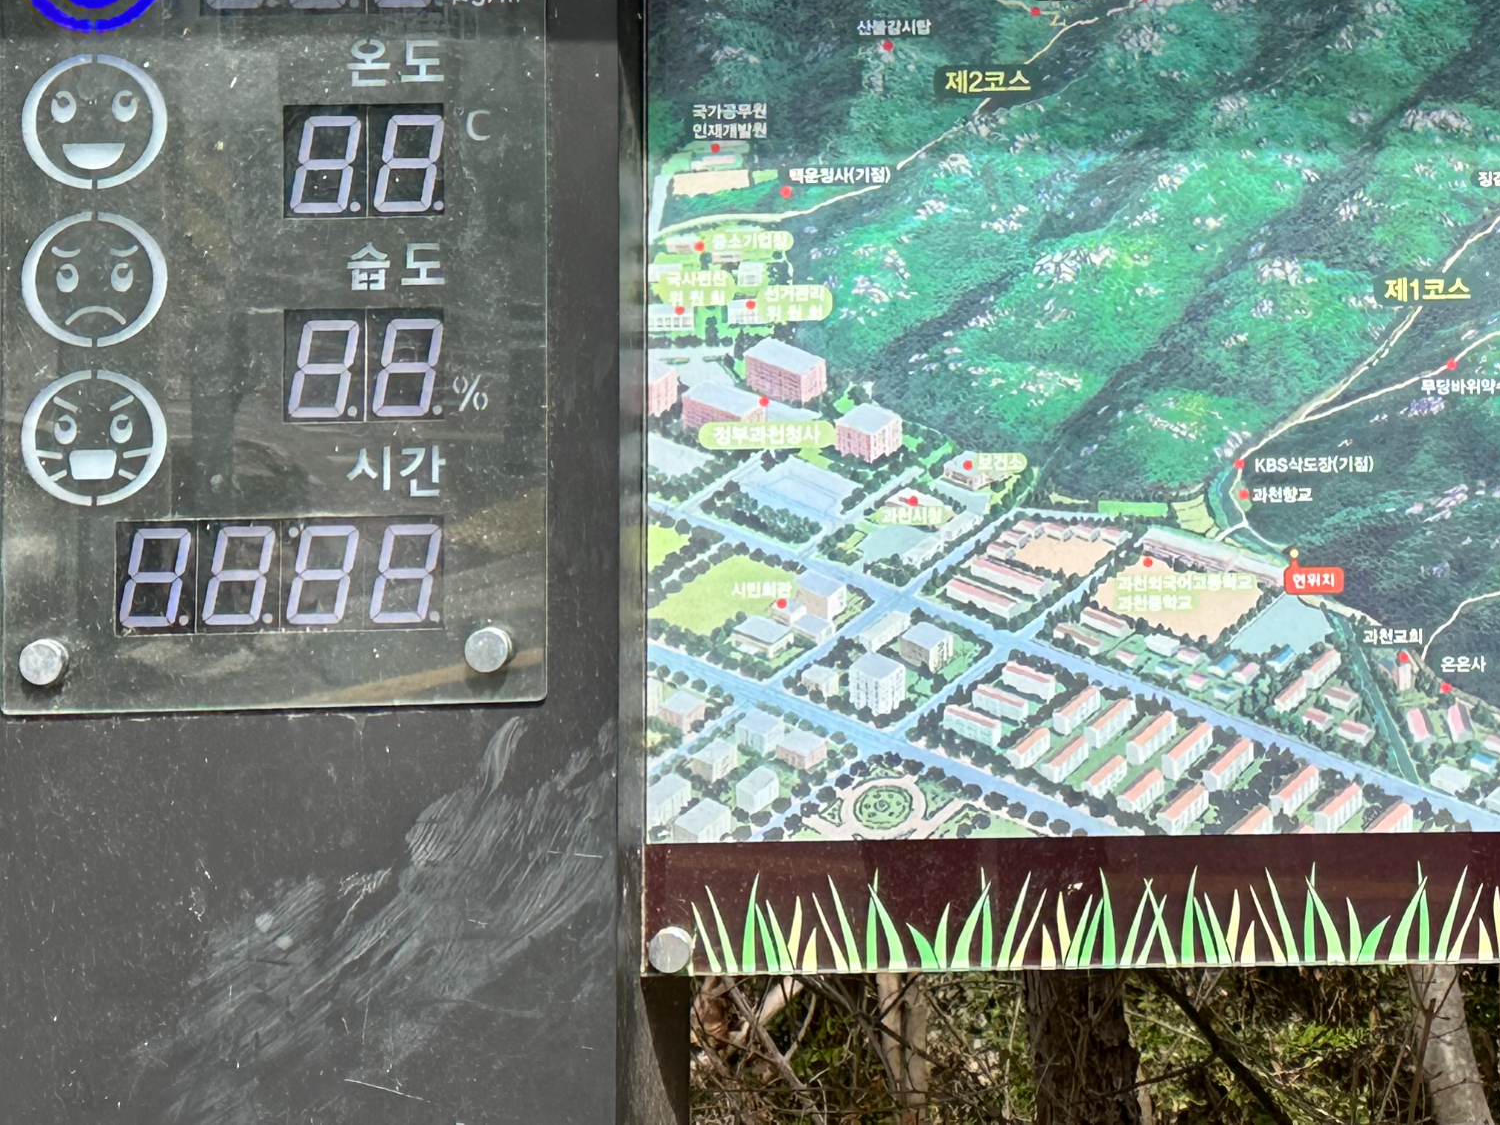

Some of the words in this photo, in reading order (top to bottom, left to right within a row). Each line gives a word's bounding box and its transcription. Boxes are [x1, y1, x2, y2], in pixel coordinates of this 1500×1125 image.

[347, 38, 445, 87] 온도
[945, 70, 1031, 94] 제2코스
[692, 103, 767, 120] 국가공무원
[692, 123, 767, 139] 인재개발원
[347, 242, 445, 291] 습도
[1384, 278, 1471, 302] 제1코스
[452, 374, 489, 413] %
[347, 445, 445, 498] 시간
[1252, 486, 1313, 504] 과천향교
[1363, 628, 1423, 645] 과천교회
[1441, 655, 1487, 673] 온온사
